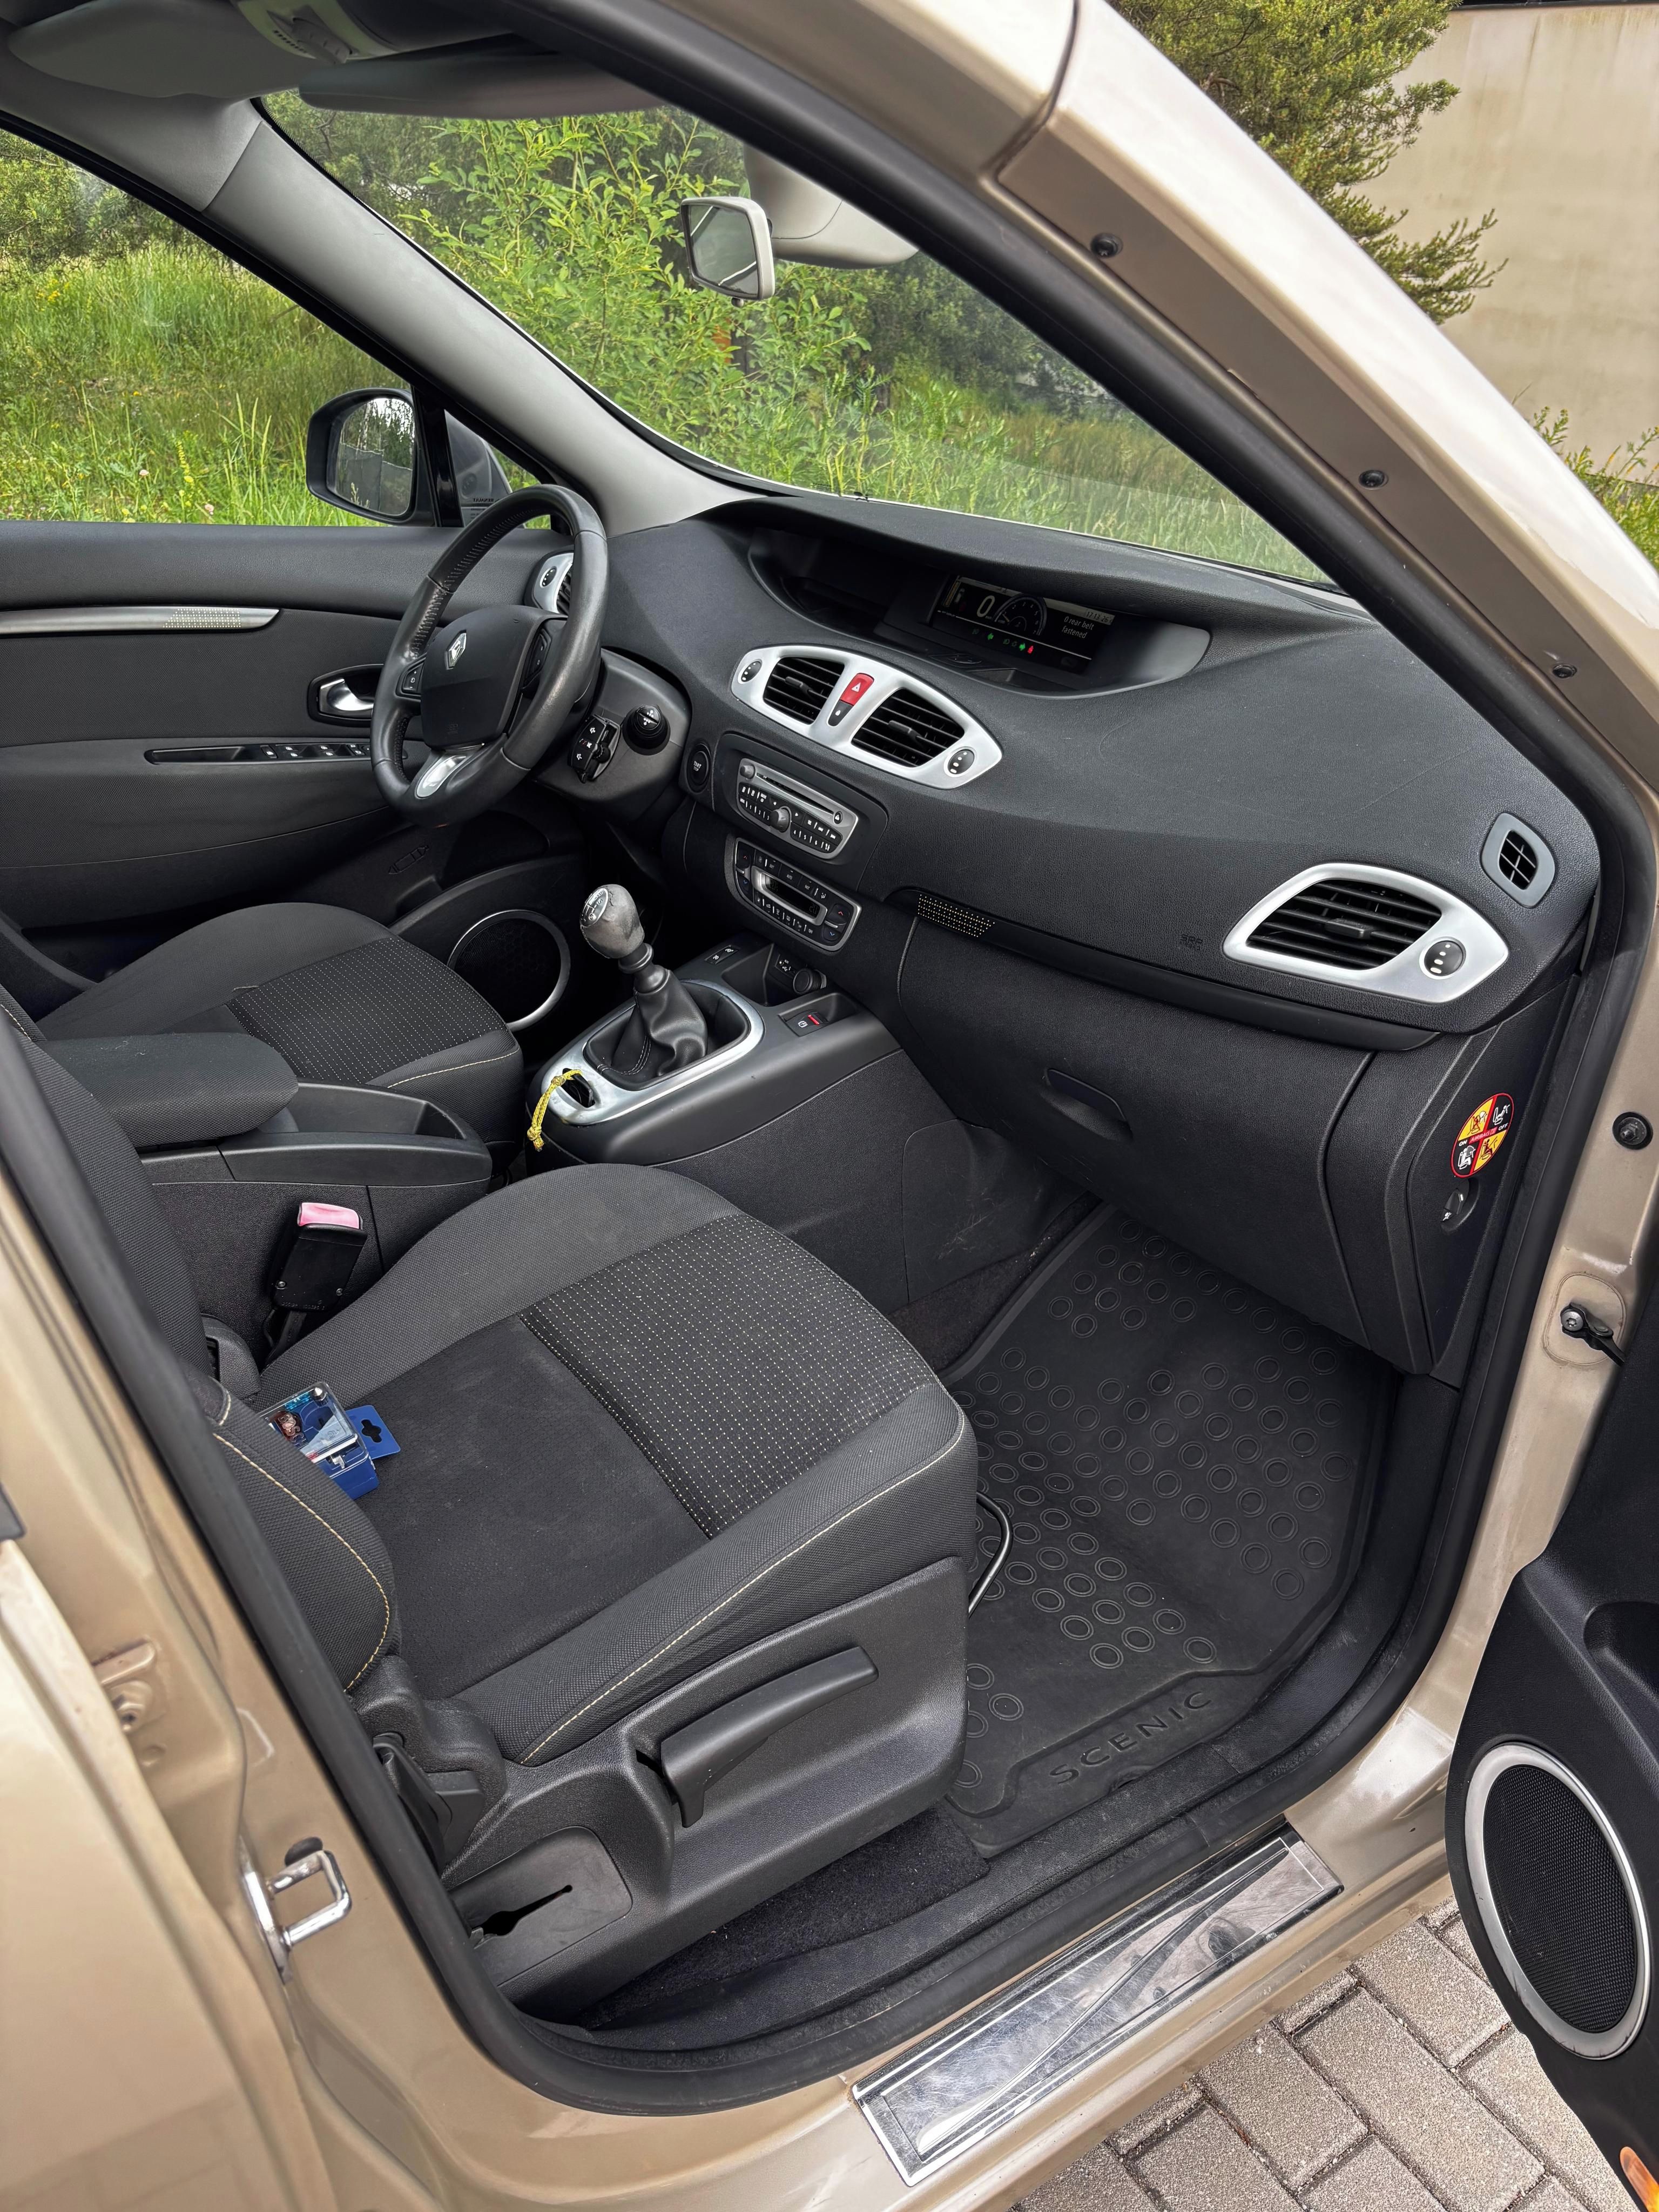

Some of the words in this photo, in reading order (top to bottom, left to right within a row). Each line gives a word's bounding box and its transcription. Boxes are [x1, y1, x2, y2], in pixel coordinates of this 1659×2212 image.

[976, 595, 995, 618] 0
[1062, 625, 1088, 638] fastened
[1082, 621, 1095, 630] belt
[1470, 1131, 1490, 1142] AIRBAG
[1498, 1123, 1508, 1131] OFF
[1049, 1691, 1212, 1785] SCENIC
